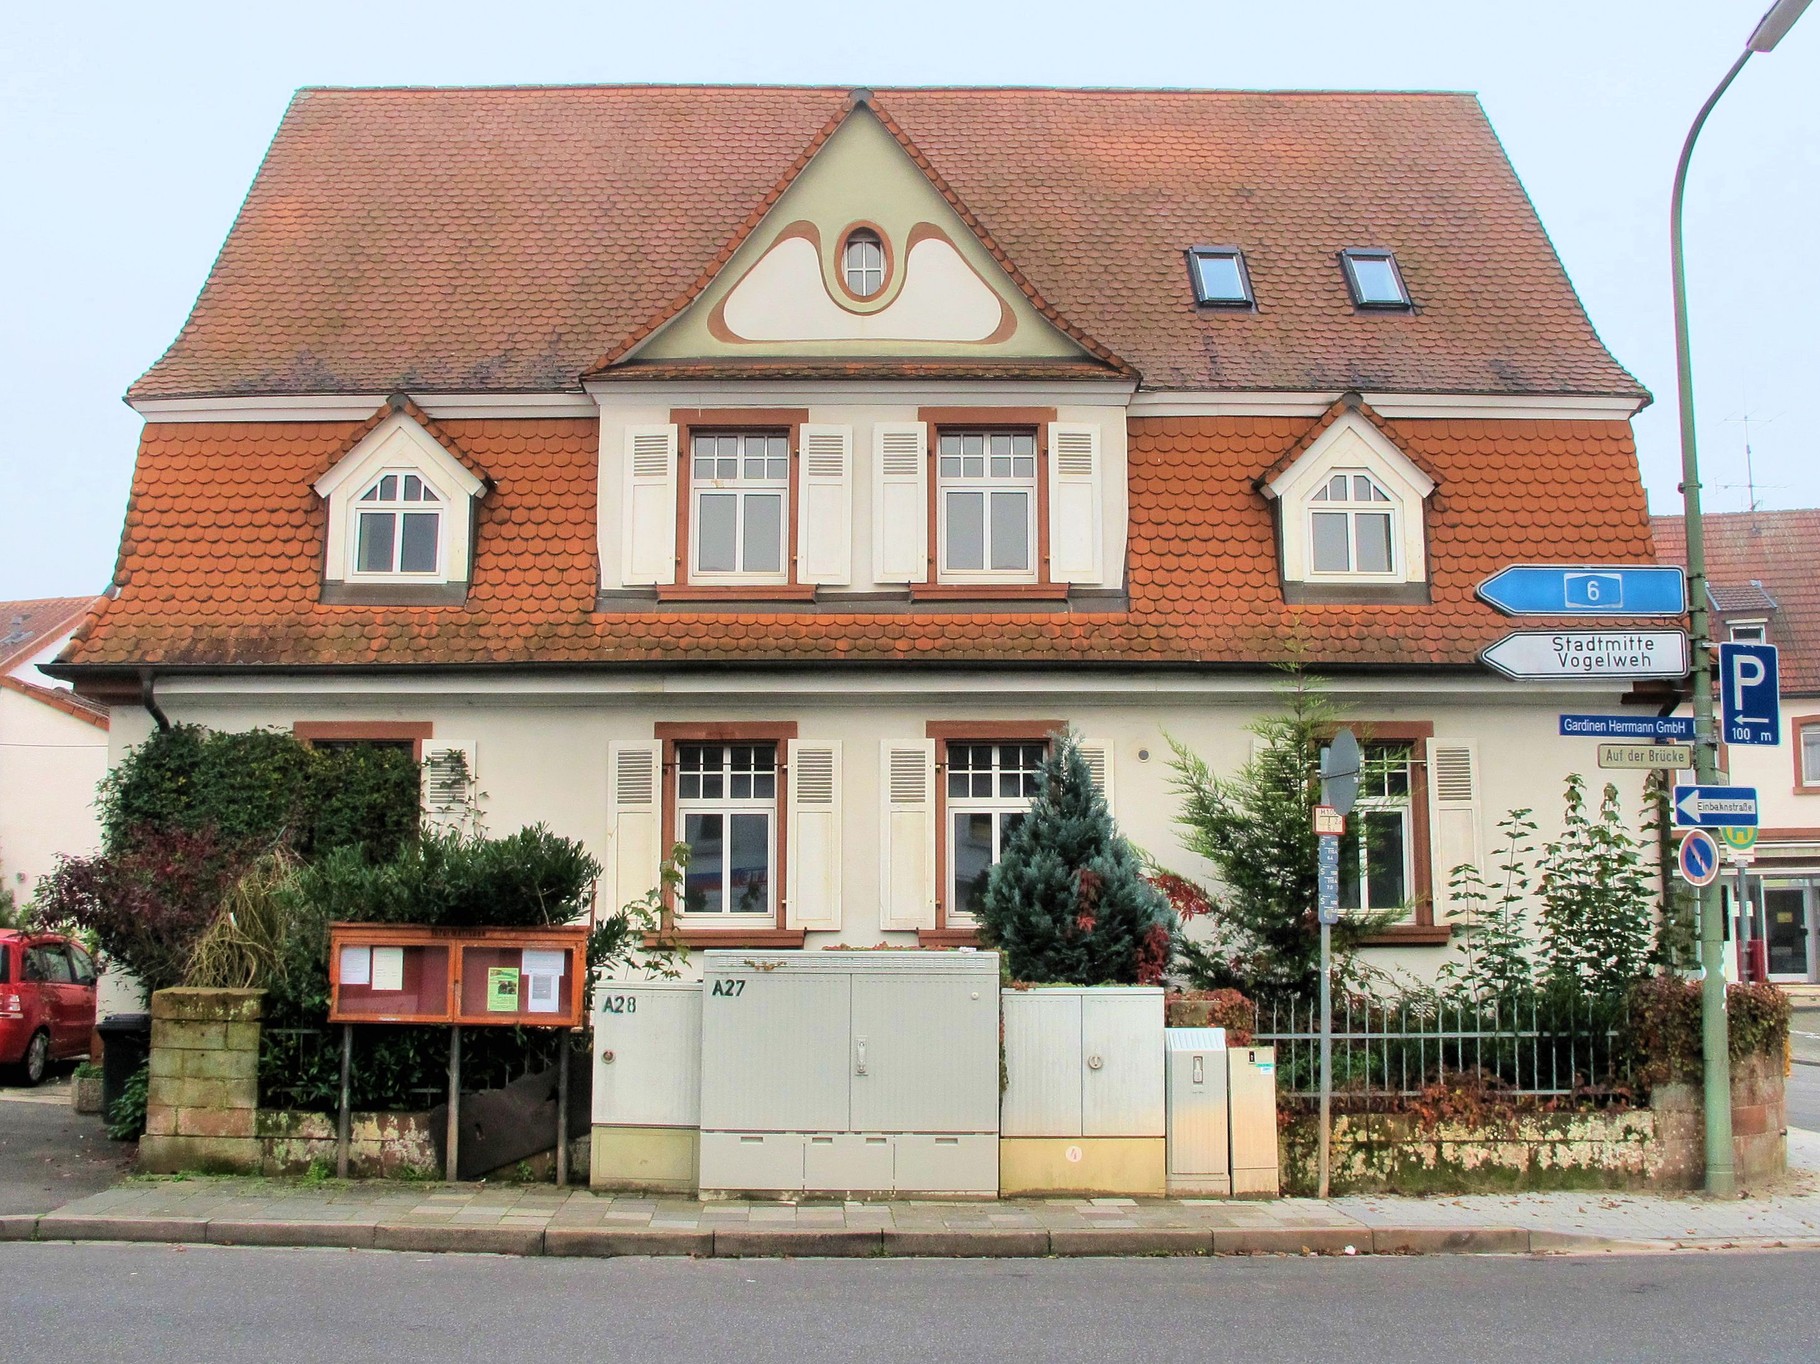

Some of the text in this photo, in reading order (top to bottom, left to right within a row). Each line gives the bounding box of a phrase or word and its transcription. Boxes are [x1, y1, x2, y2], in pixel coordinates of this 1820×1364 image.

[1587, 580, 1599, 601] 6
[1553, 635, 1654, 651] Stadtmitte
[1558, 652, 1651, 671] Vogelweh
[1732, 654, 1765, 711] P
[1564, 718, 1686, 734] Gardinen Herrmann GmbH
[1732, 727, 1772, 741] 100 m
[1606, 749, 1684, 763] Auf der Brücke
[1697, 801, 1752, 812] Einbahnstraße
[712, 979, 746, 997] A27
[602, 996, 637, 1014] A28
